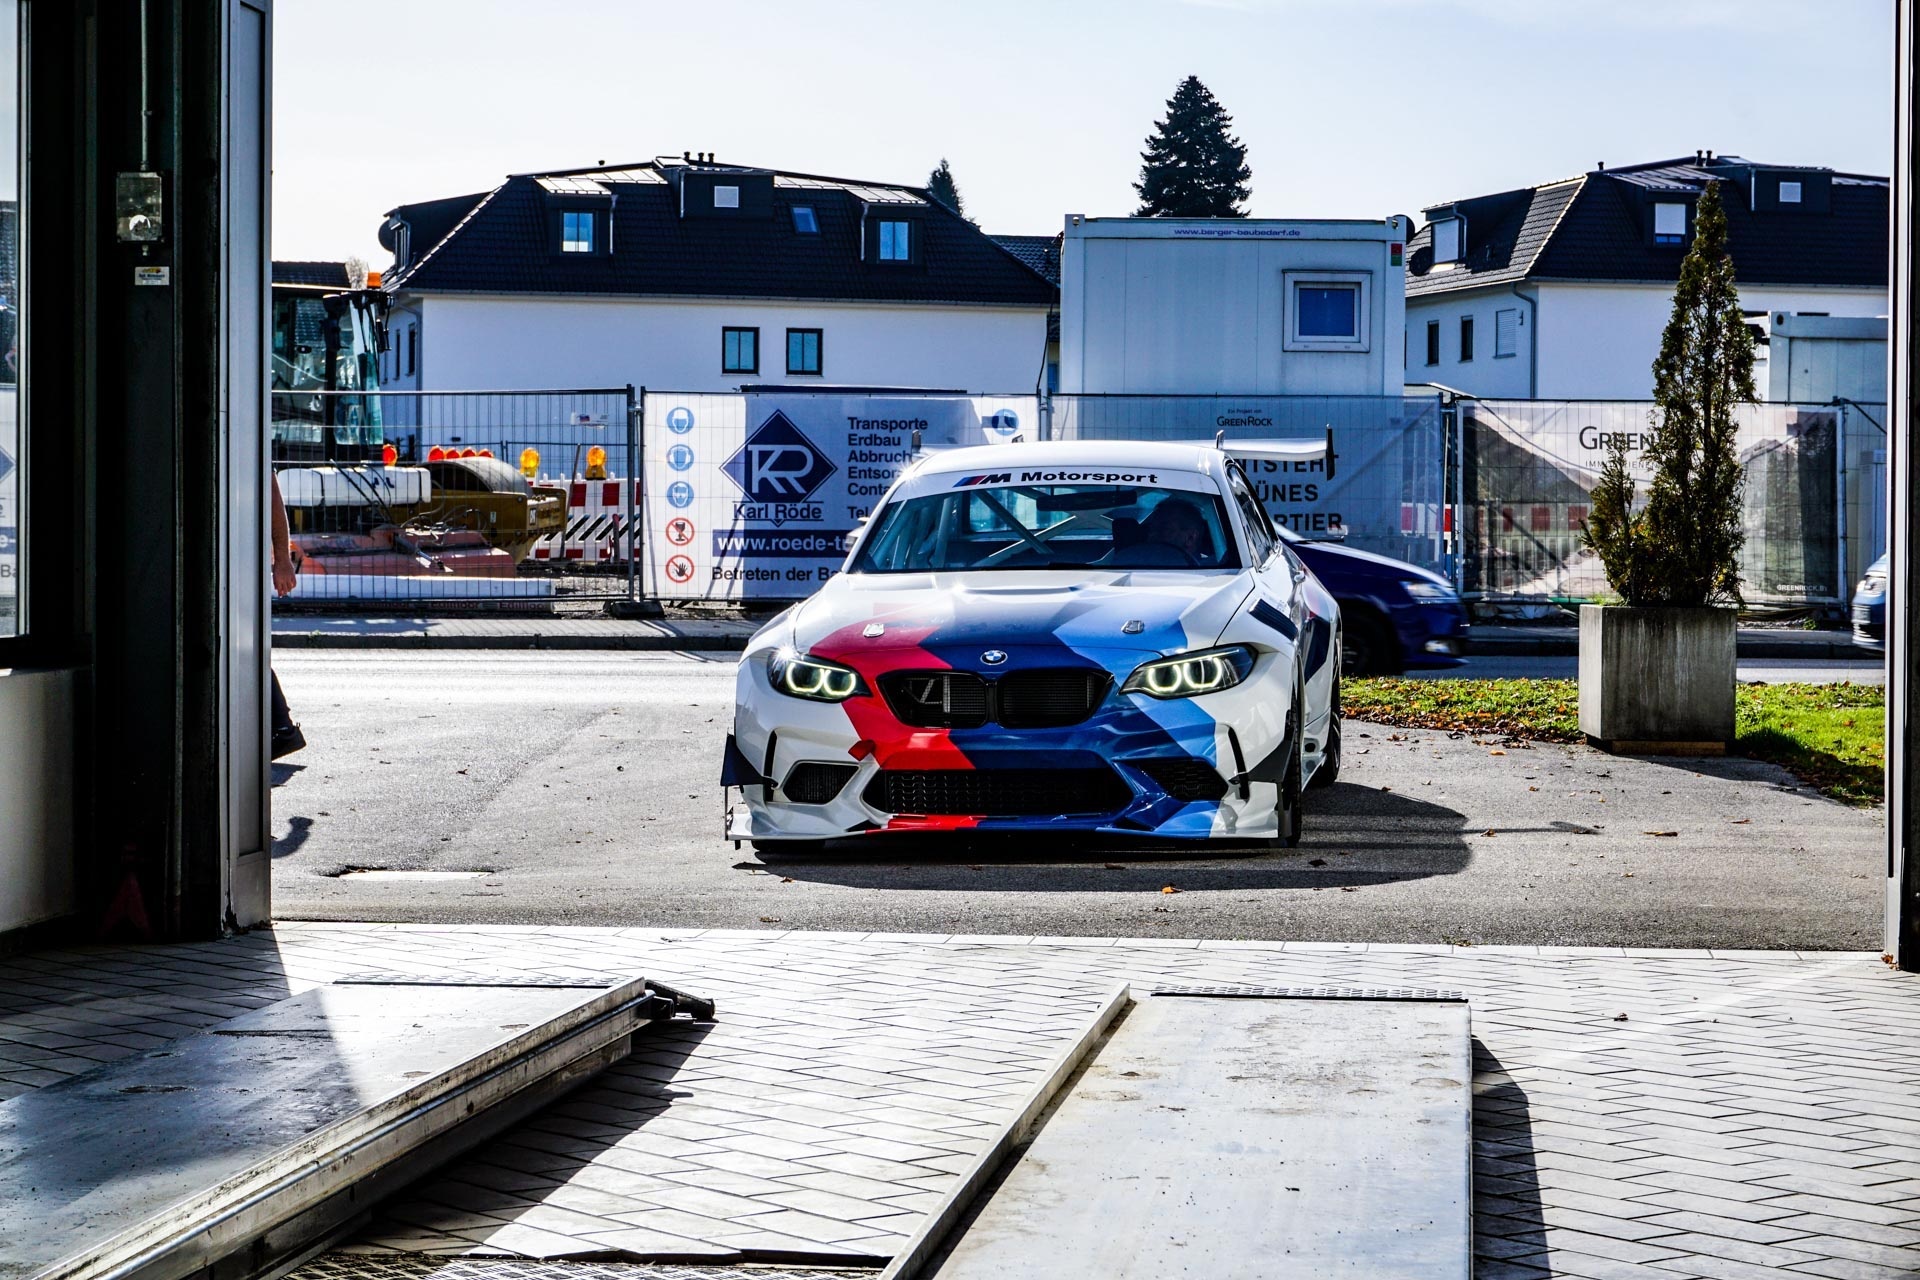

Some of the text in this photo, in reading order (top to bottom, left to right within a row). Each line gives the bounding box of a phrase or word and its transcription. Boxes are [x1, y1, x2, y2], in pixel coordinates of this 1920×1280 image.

[1174, 228, 1301, 237] www.berger-baubedarf.de
[847, 416, 929, 434] Transporte
[847, 433, 902, 447] Erdbau
[847, 449, 912, 463] Abbruch
[847, 466, 902, 479] Entsor
[1020, 472, 1158, 484] Motorsport
[733, 503, 823, 519] Karl Röde
[711, 566, 781, 581] Betreten
[785, 566, 813, 581] der
